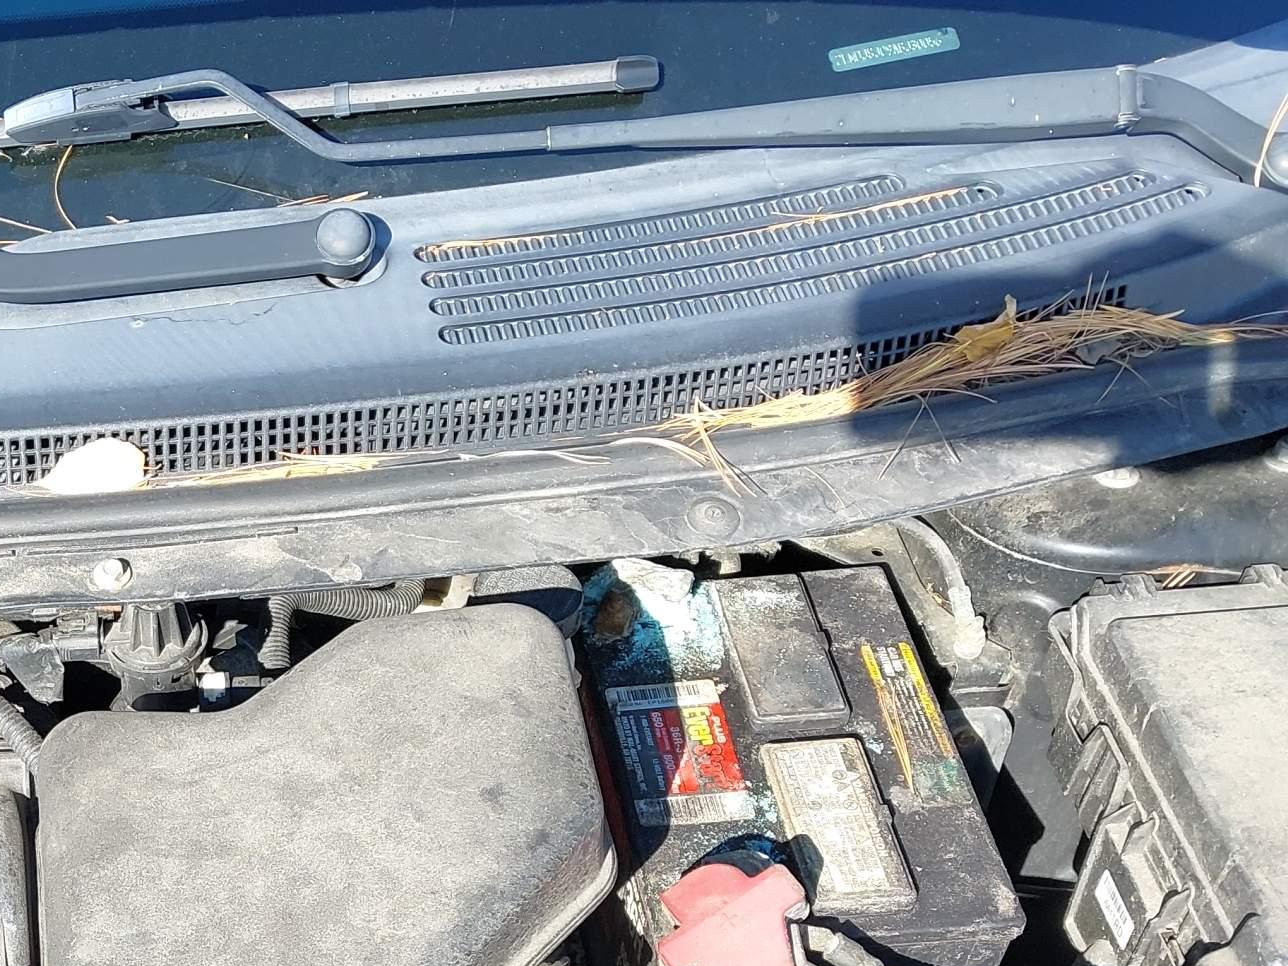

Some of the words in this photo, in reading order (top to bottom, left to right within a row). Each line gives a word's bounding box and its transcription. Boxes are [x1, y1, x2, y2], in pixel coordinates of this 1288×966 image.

[652, 712, 664, 728] 650
[712, 716, 726, 744] PLUS
[664, 754, 675, 770] 800
